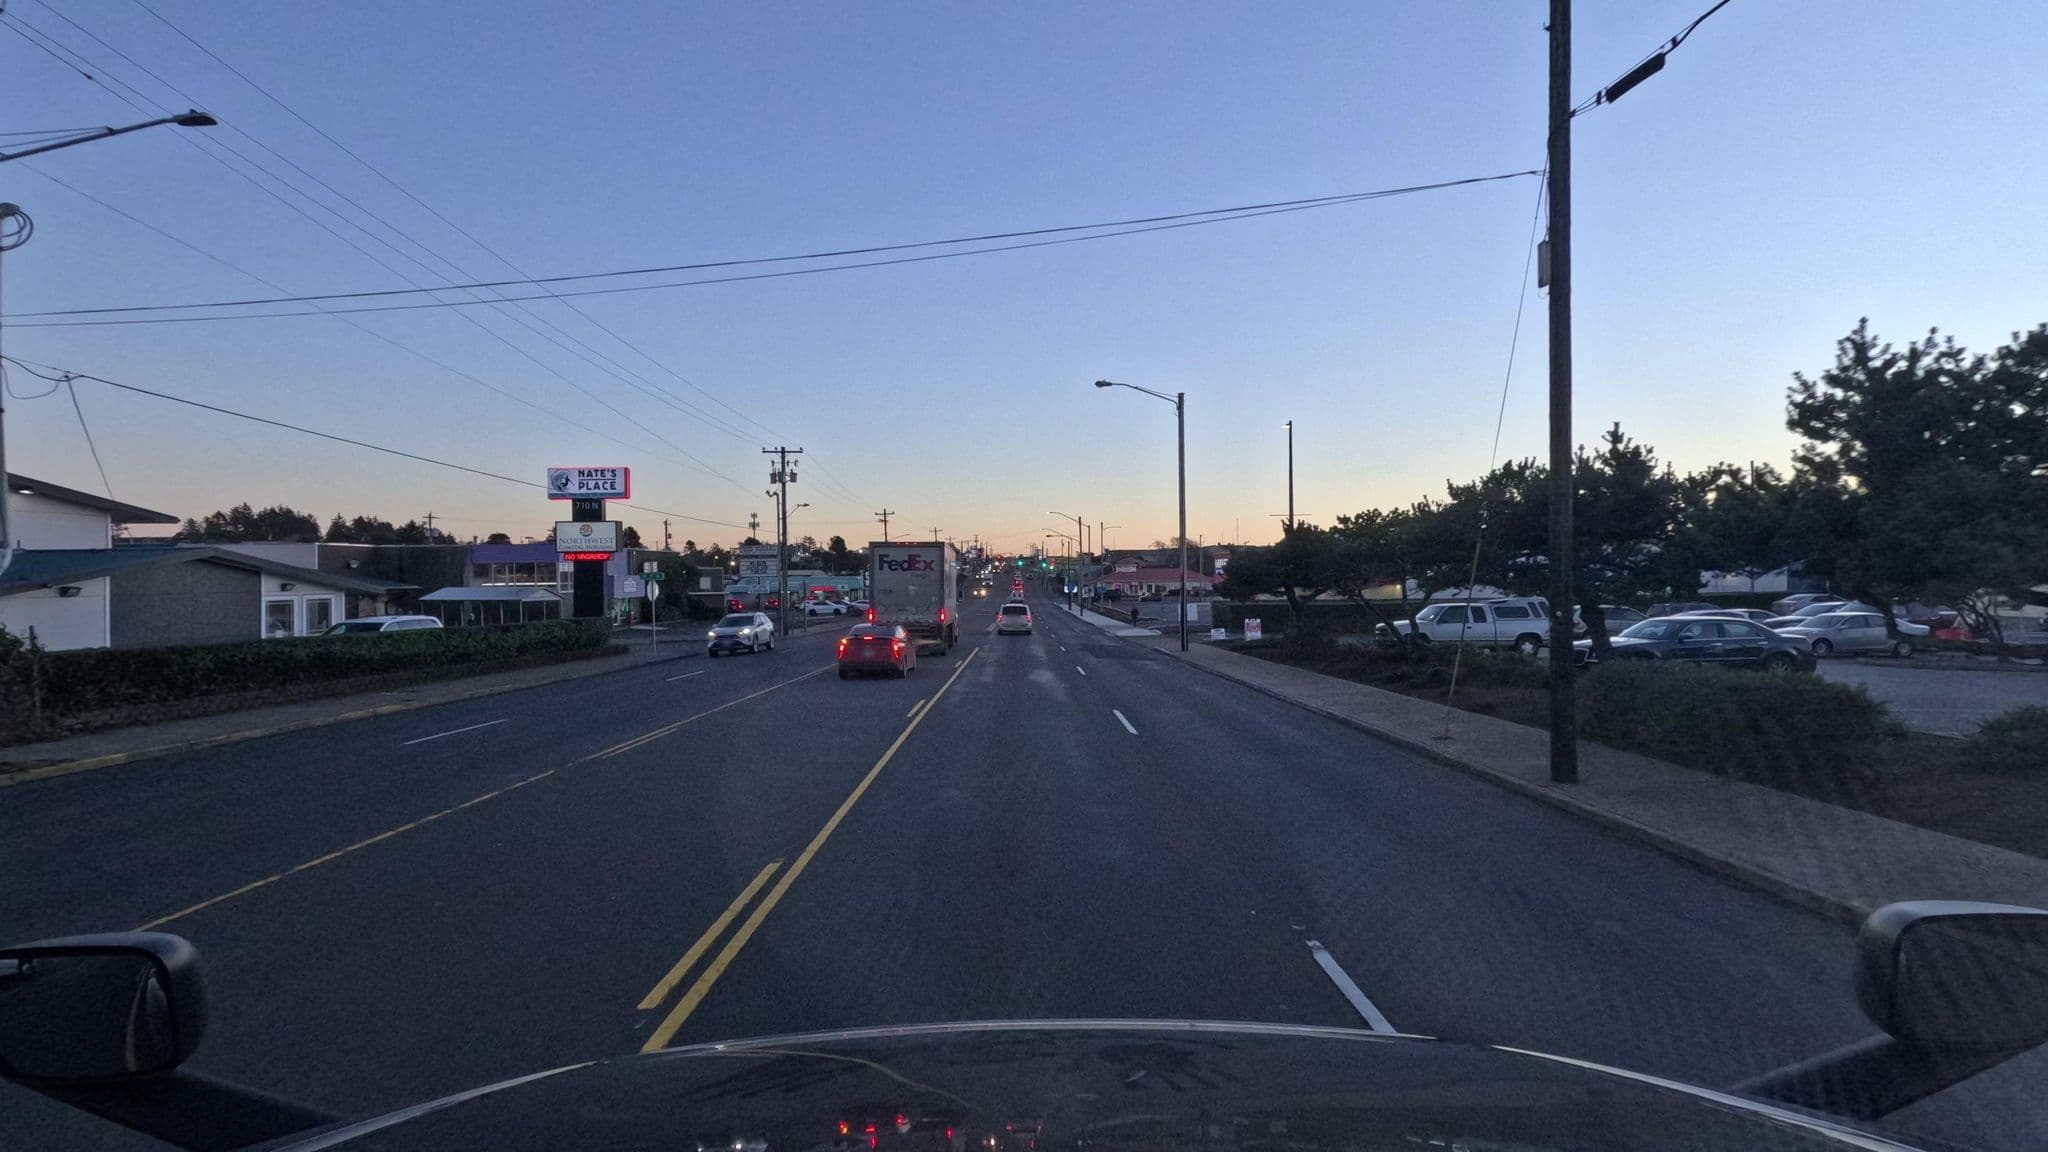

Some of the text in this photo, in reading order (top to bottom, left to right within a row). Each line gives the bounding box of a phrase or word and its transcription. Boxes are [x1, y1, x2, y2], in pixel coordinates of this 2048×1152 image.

[578, 469, 617, 478] NATE'S
[578, 481, 617, 491] PLACE
[576, 502, 599, 510] 710 N
[878, 553, 935, 572] FedEx
